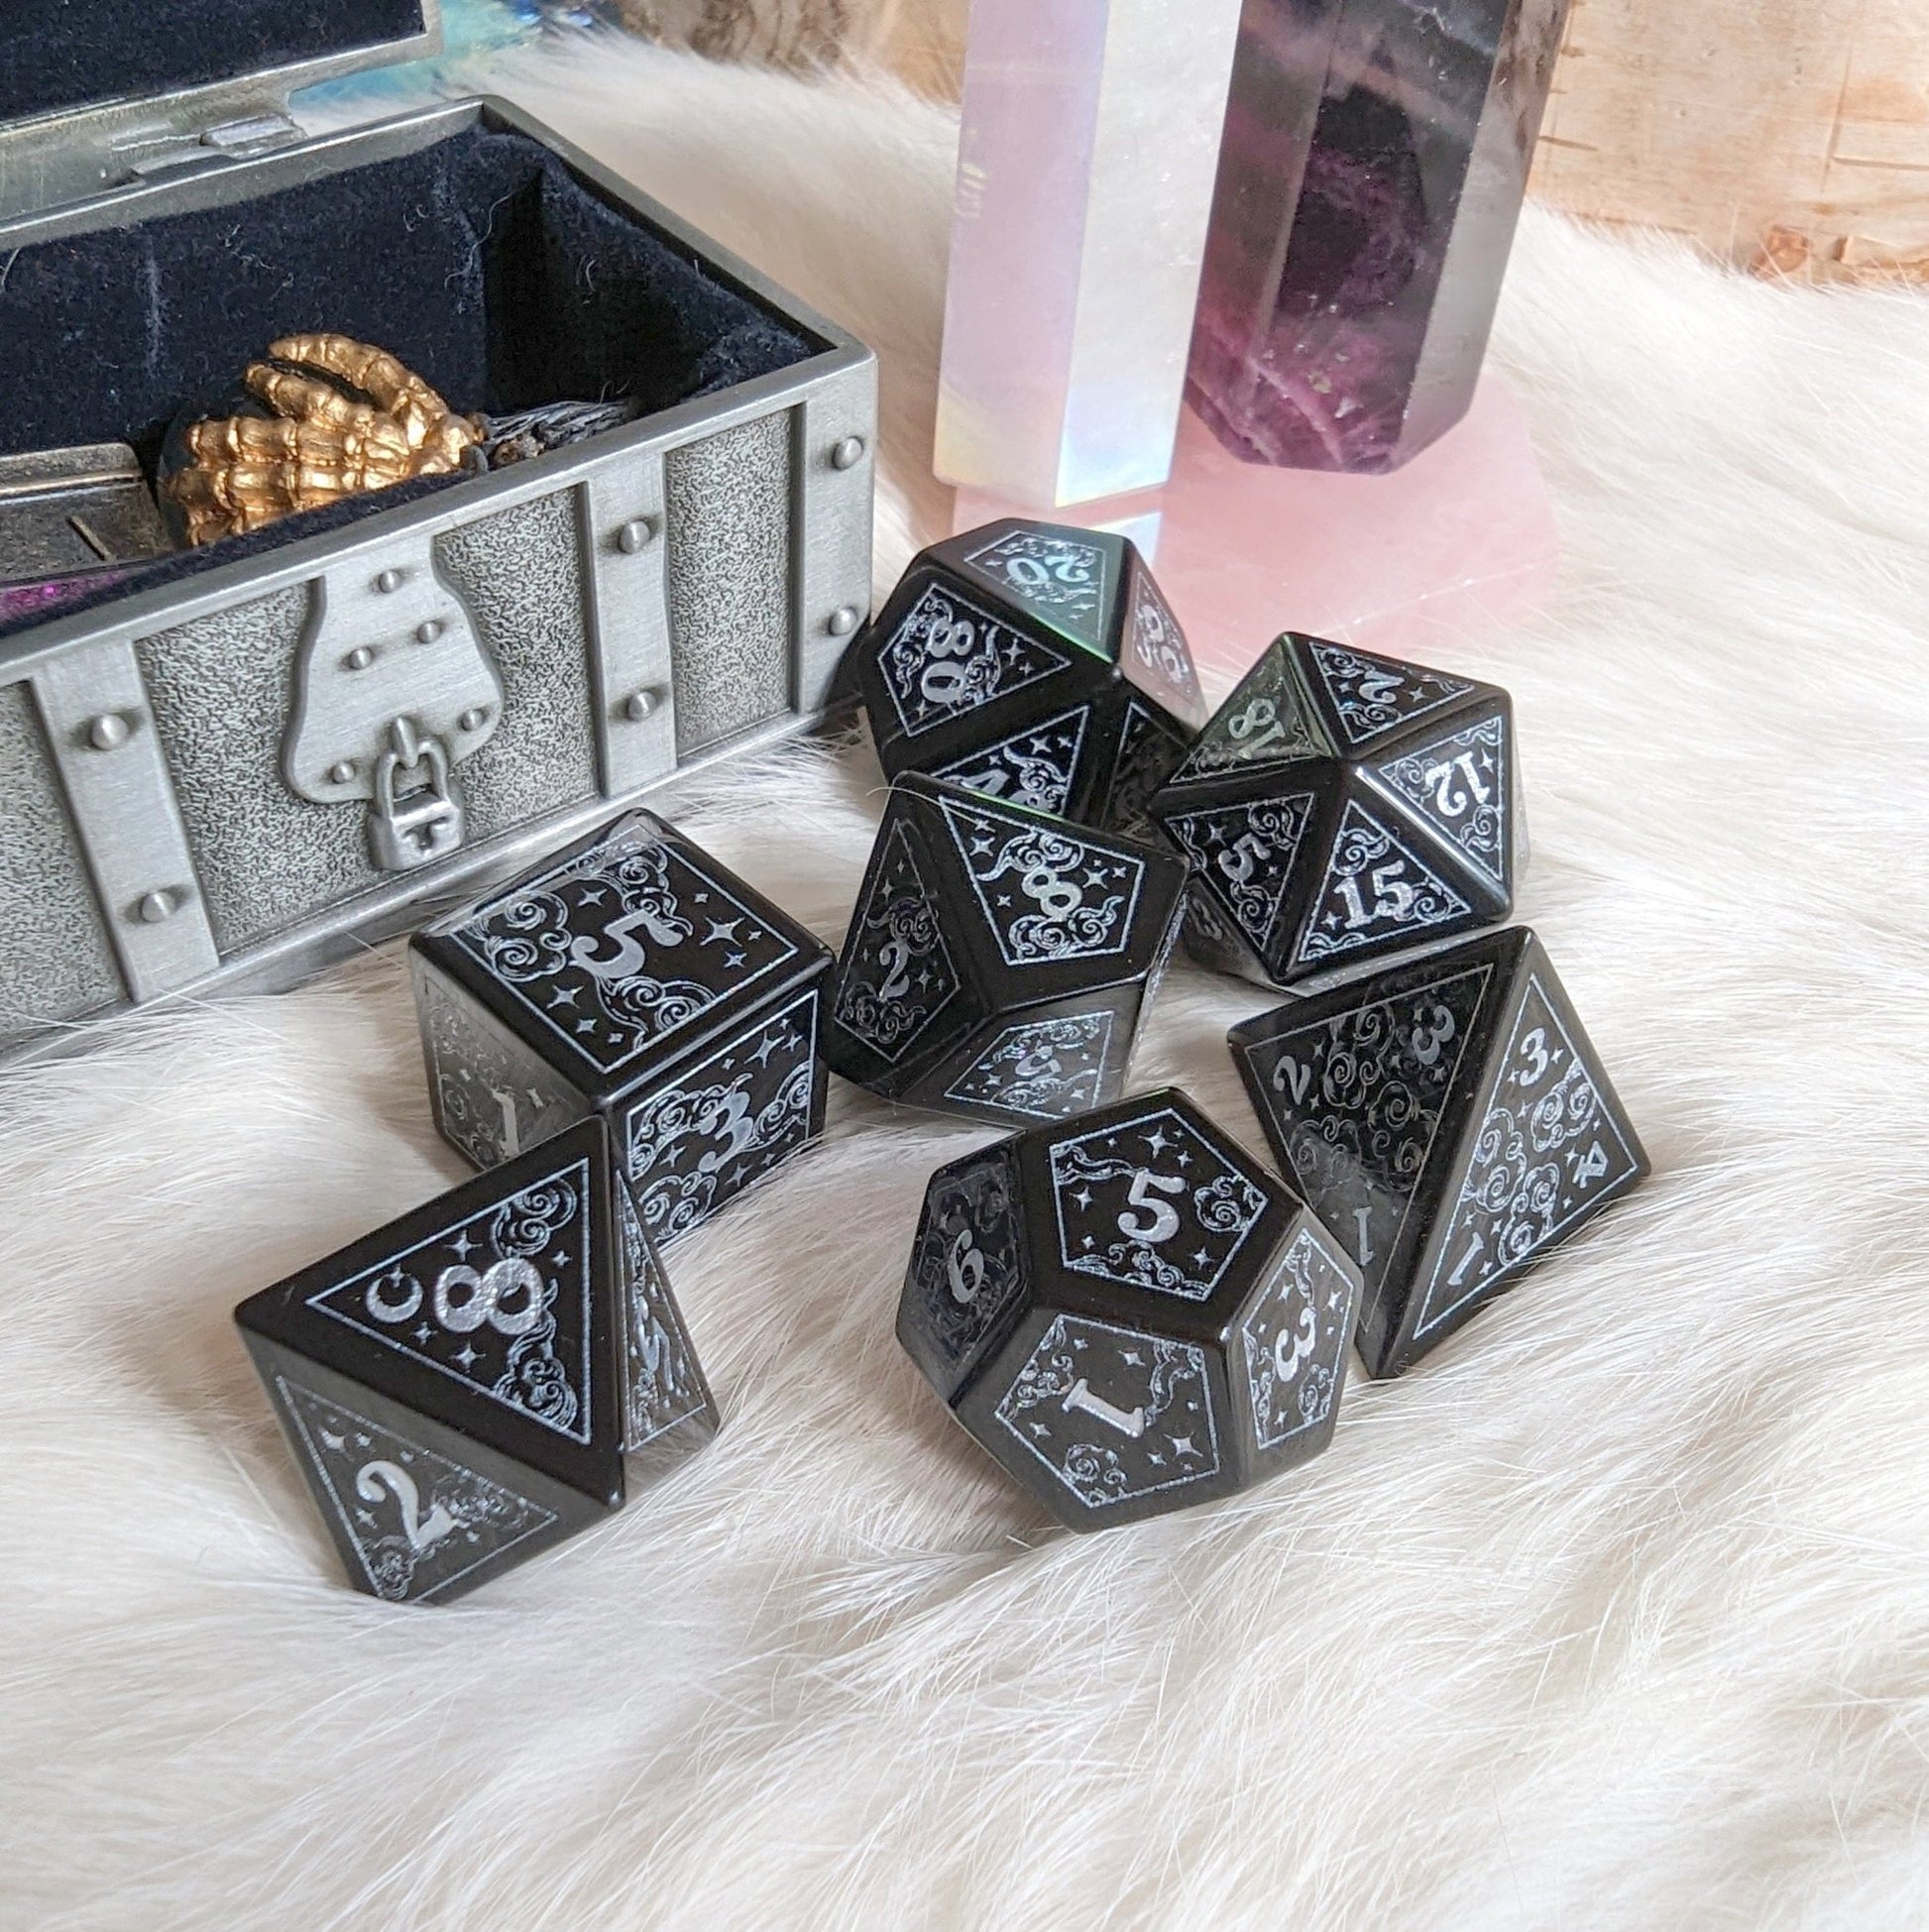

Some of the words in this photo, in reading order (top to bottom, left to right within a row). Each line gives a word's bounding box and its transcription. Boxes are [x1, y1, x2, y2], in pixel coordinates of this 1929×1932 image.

[1006, 554, 1090, 586] 20
[921, 618, 975, 703] 80
[1358, 670, 1405, 705] 2
[1227, 698, 1286, 759] 18
[1424, 750, 1491, 817] 12
[1218, 833, 1271, 883] 5
[1021, 866, 1082, 922] 8
[1332, 859, 1415, 930] 15
[570, 909, 683, 979] 5
[879, 942, 911, 1002] 2
[1411, 1005, 1455, 1065] 3
[1520, 1027, 1548, 1087] 3
[1273, 1055, 1312, 1105] 2
[492, 1087, 519, 1157] 1
[699, 1091, 752, 1172] 3
[1573, 1141, 1608, 1188] 4
[1117, 1171, 1188, 1242] 5
[1352, 1206, 1374, 1267] 1
[947, 1228, 984, 1304] 6
[1447, 1232, 1485, 1287] 1
[434, 1256, 544, 1335] 8
[1275, 1307, 1317, 1382] 3
[1062, 1378, 1145, 1437] 1
[356, 1460, 455, 1550] 2
